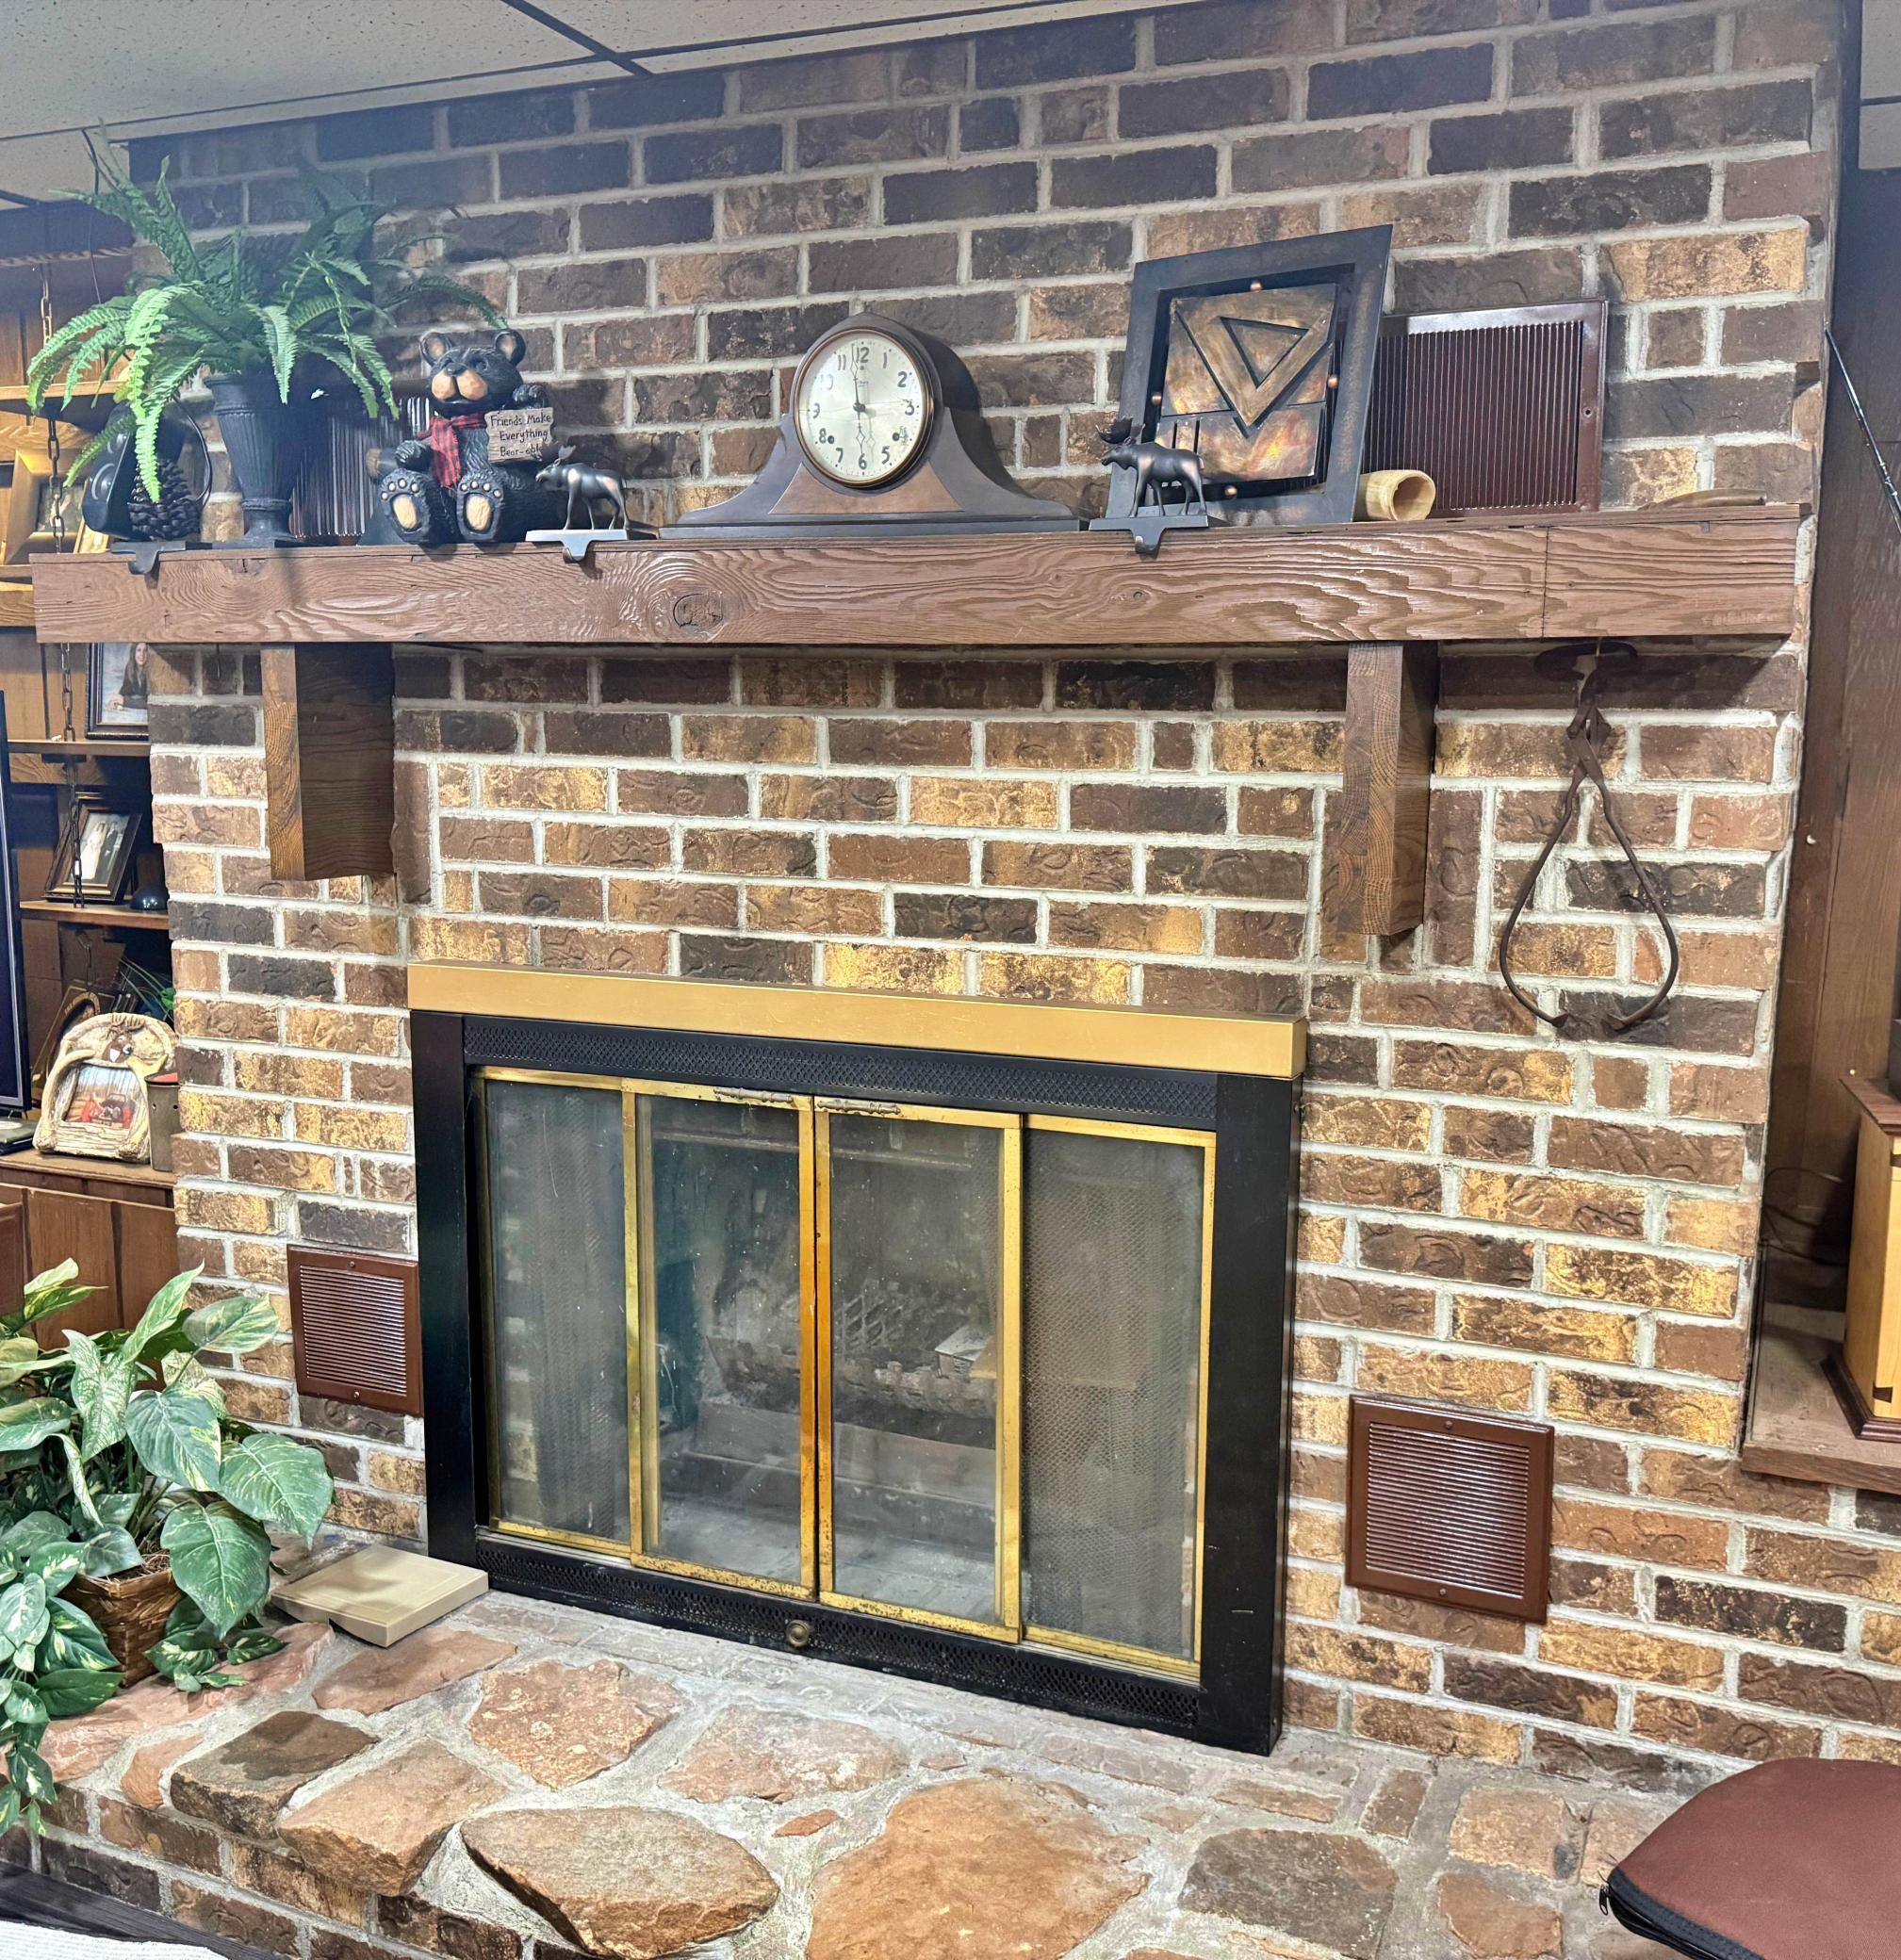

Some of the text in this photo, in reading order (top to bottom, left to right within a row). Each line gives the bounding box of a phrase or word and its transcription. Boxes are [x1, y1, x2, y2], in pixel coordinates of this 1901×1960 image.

[837, 353, 847, 371] 11
[855, 346, 870, 364] 12
[882, 351, 888, 369] 1
[897, 370, 908, 388] 2
[904, 399, 915, 416] 3
[490, 412, 551, 427] Friends Make
[500, 429, 548, 443] Everything
[818, 427, 827, 444] 8
[835, 447, 844, 464] 7
[858, 452, 867, 470] 6
[881, 446, 891, 465] 5
